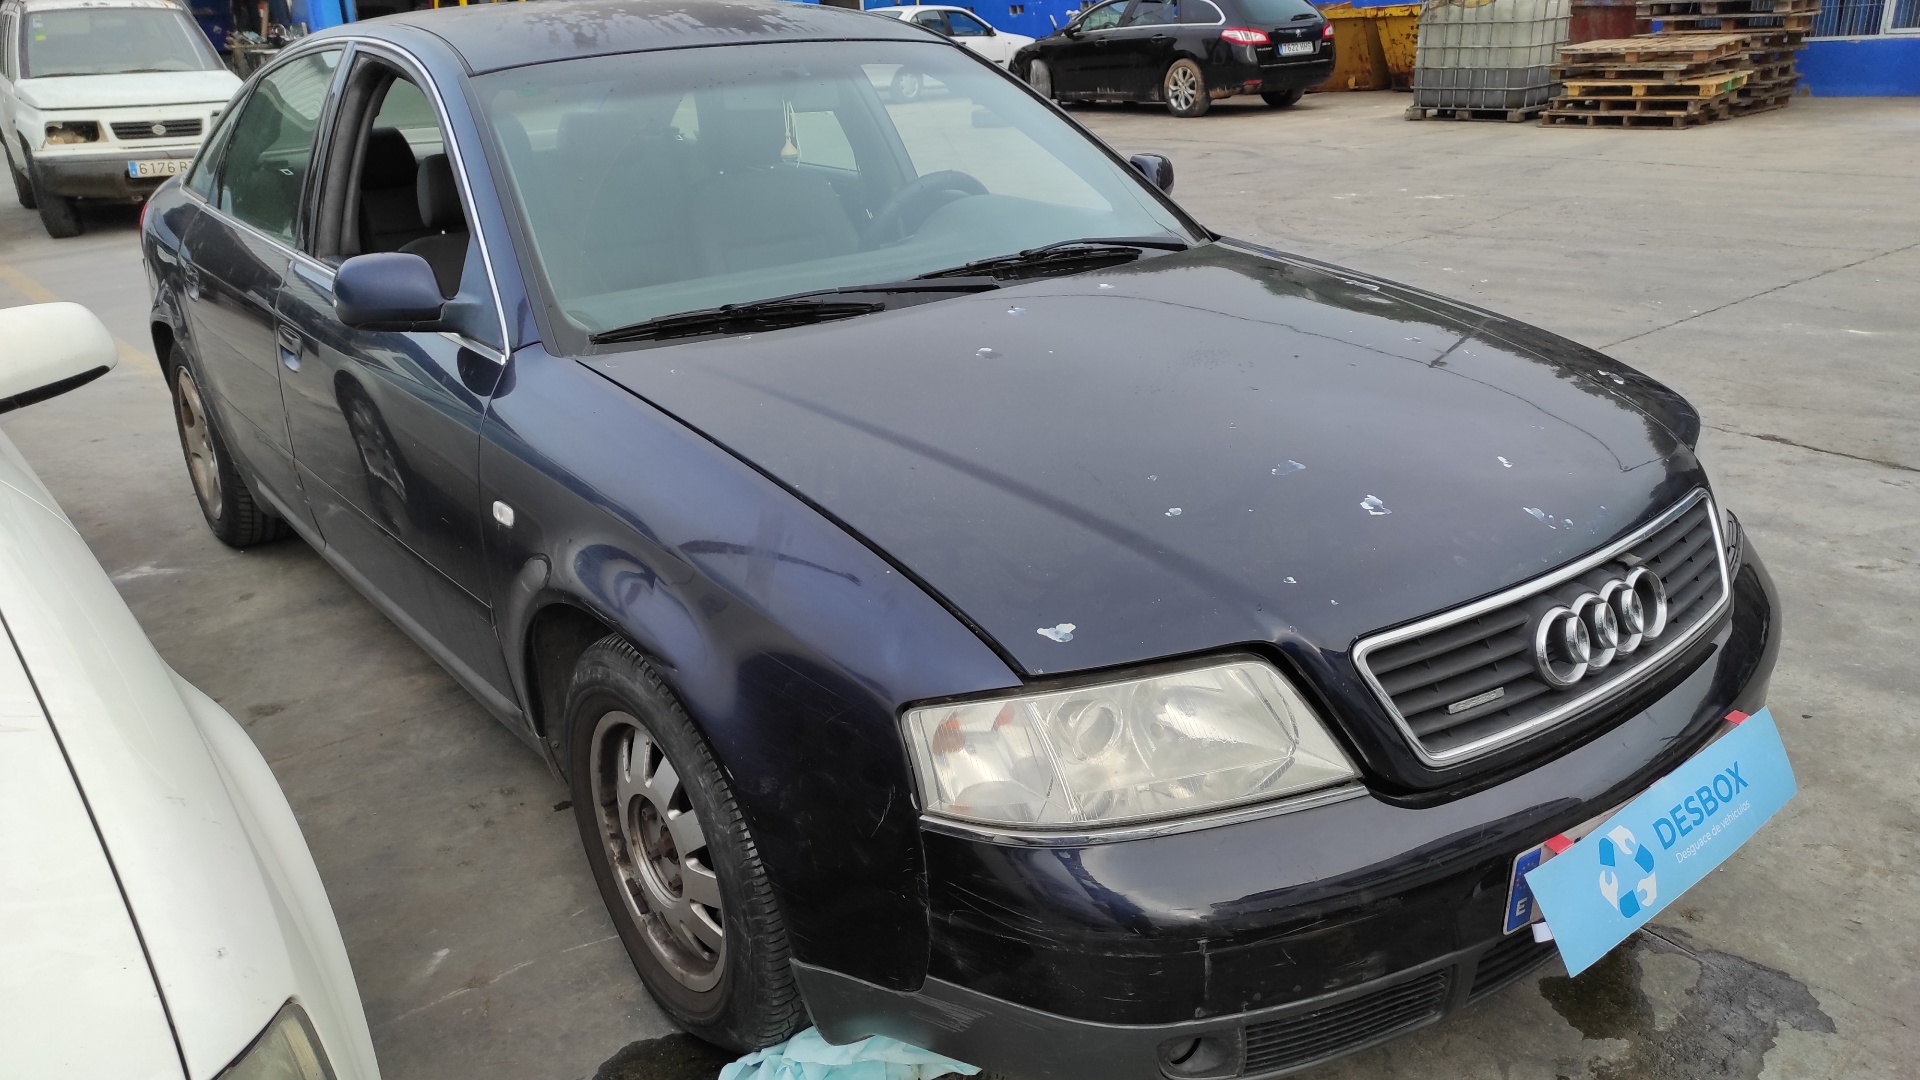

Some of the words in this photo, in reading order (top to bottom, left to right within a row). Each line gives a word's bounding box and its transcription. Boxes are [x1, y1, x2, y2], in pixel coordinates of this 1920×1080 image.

[139, 161, 176, 174] 6176
[1652, 761, 1749, 850] DESBOX
[1675, 832, 1712, 864] Desguace
[1711, 824, 1721, 836] de
[1516, 897, 1527, 916] E
